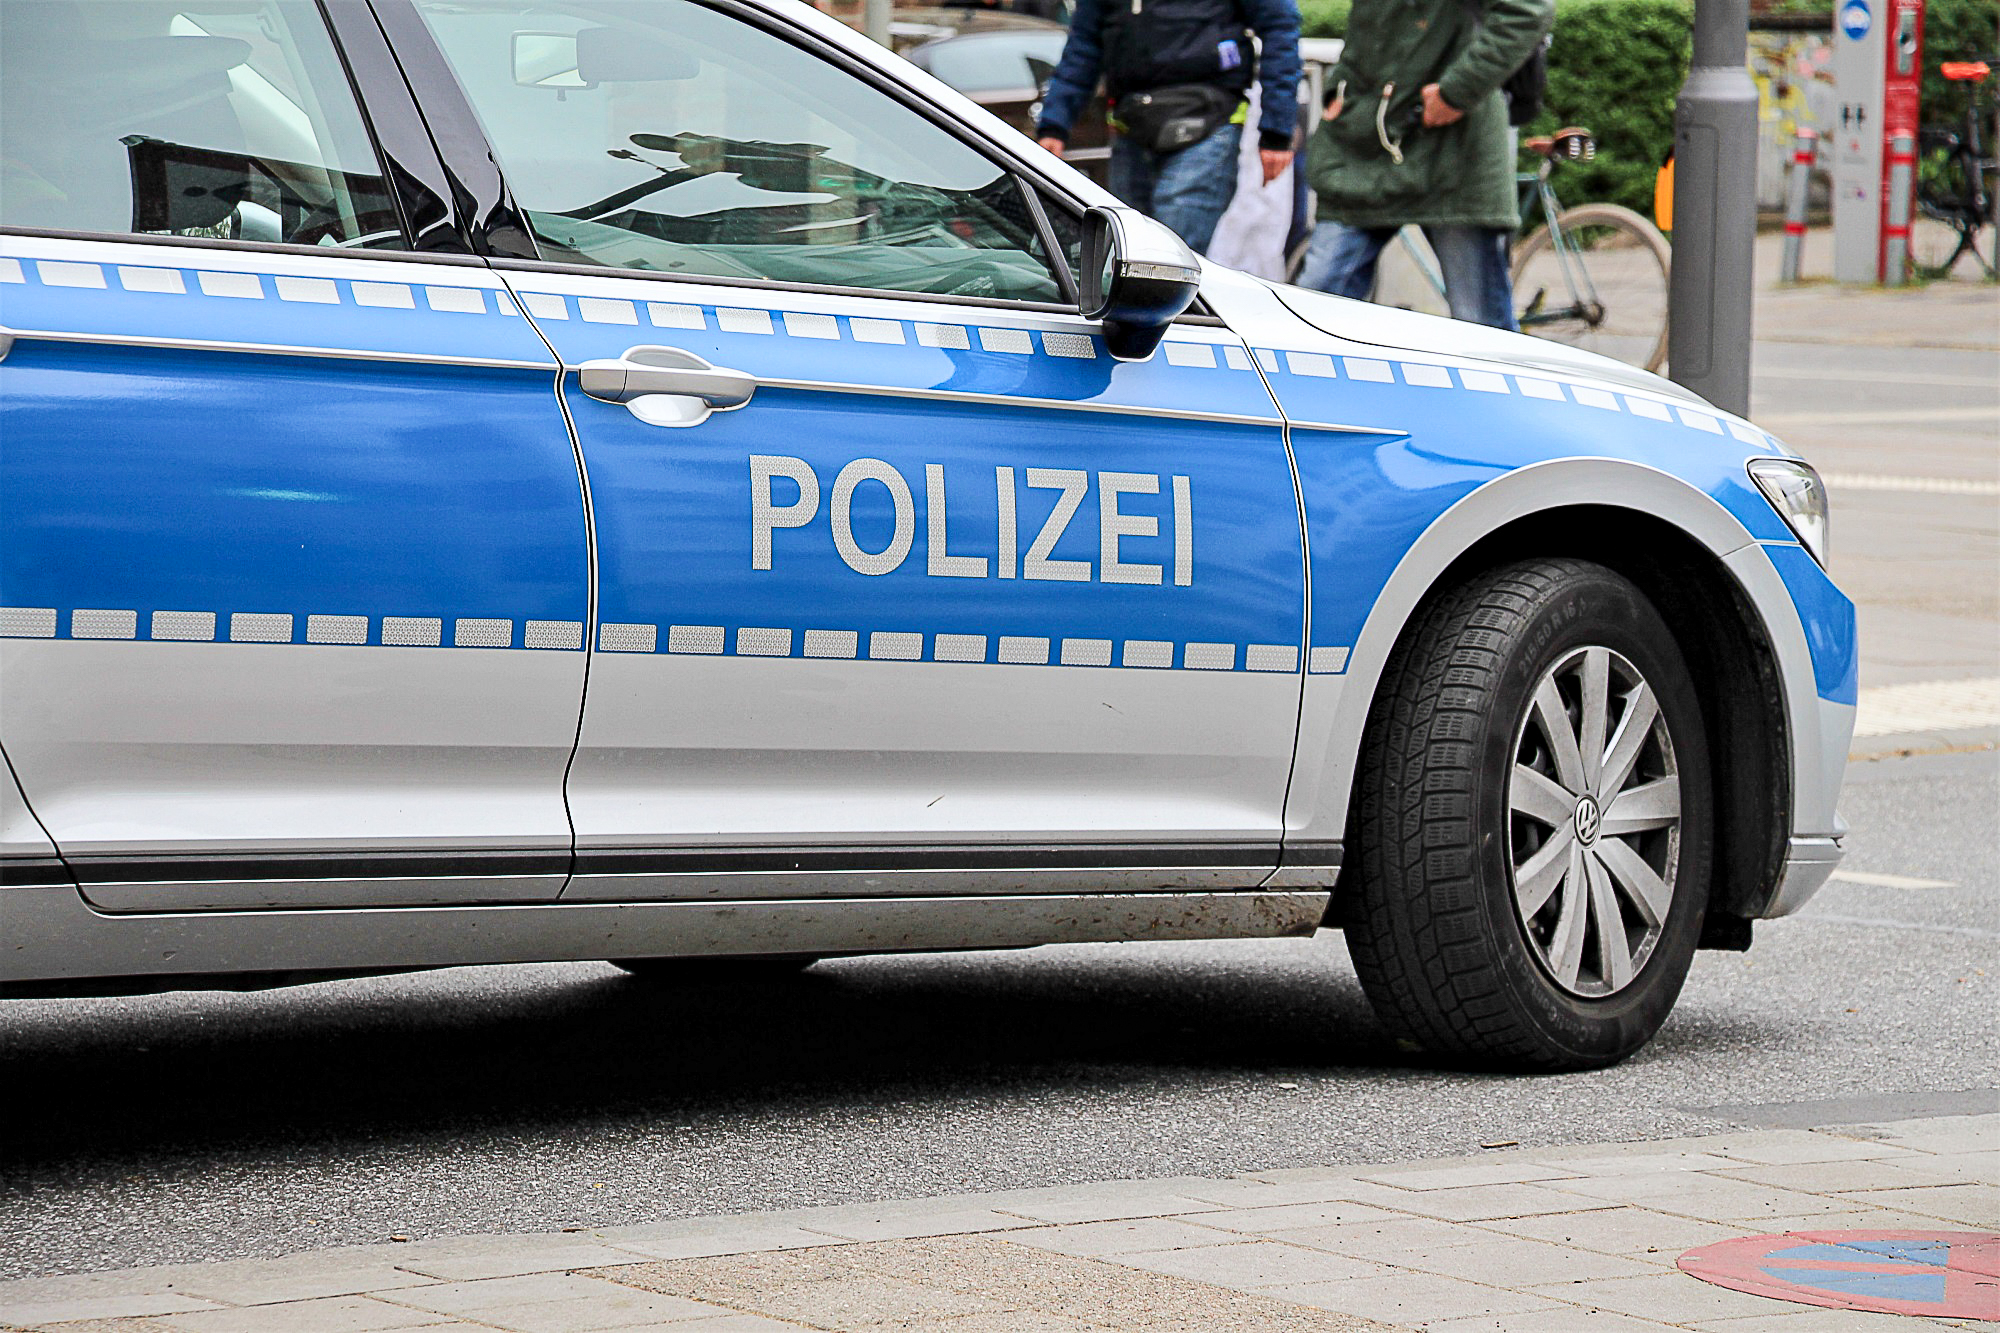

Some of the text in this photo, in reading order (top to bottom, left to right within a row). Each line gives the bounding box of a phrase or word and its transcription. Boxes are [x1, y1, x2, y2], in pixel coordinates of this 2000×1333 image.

[749, 454, 1192, 586] POLIZEI
[1551, 612, 1563, 630] R
[1562, 601, 1577, 620] 16
